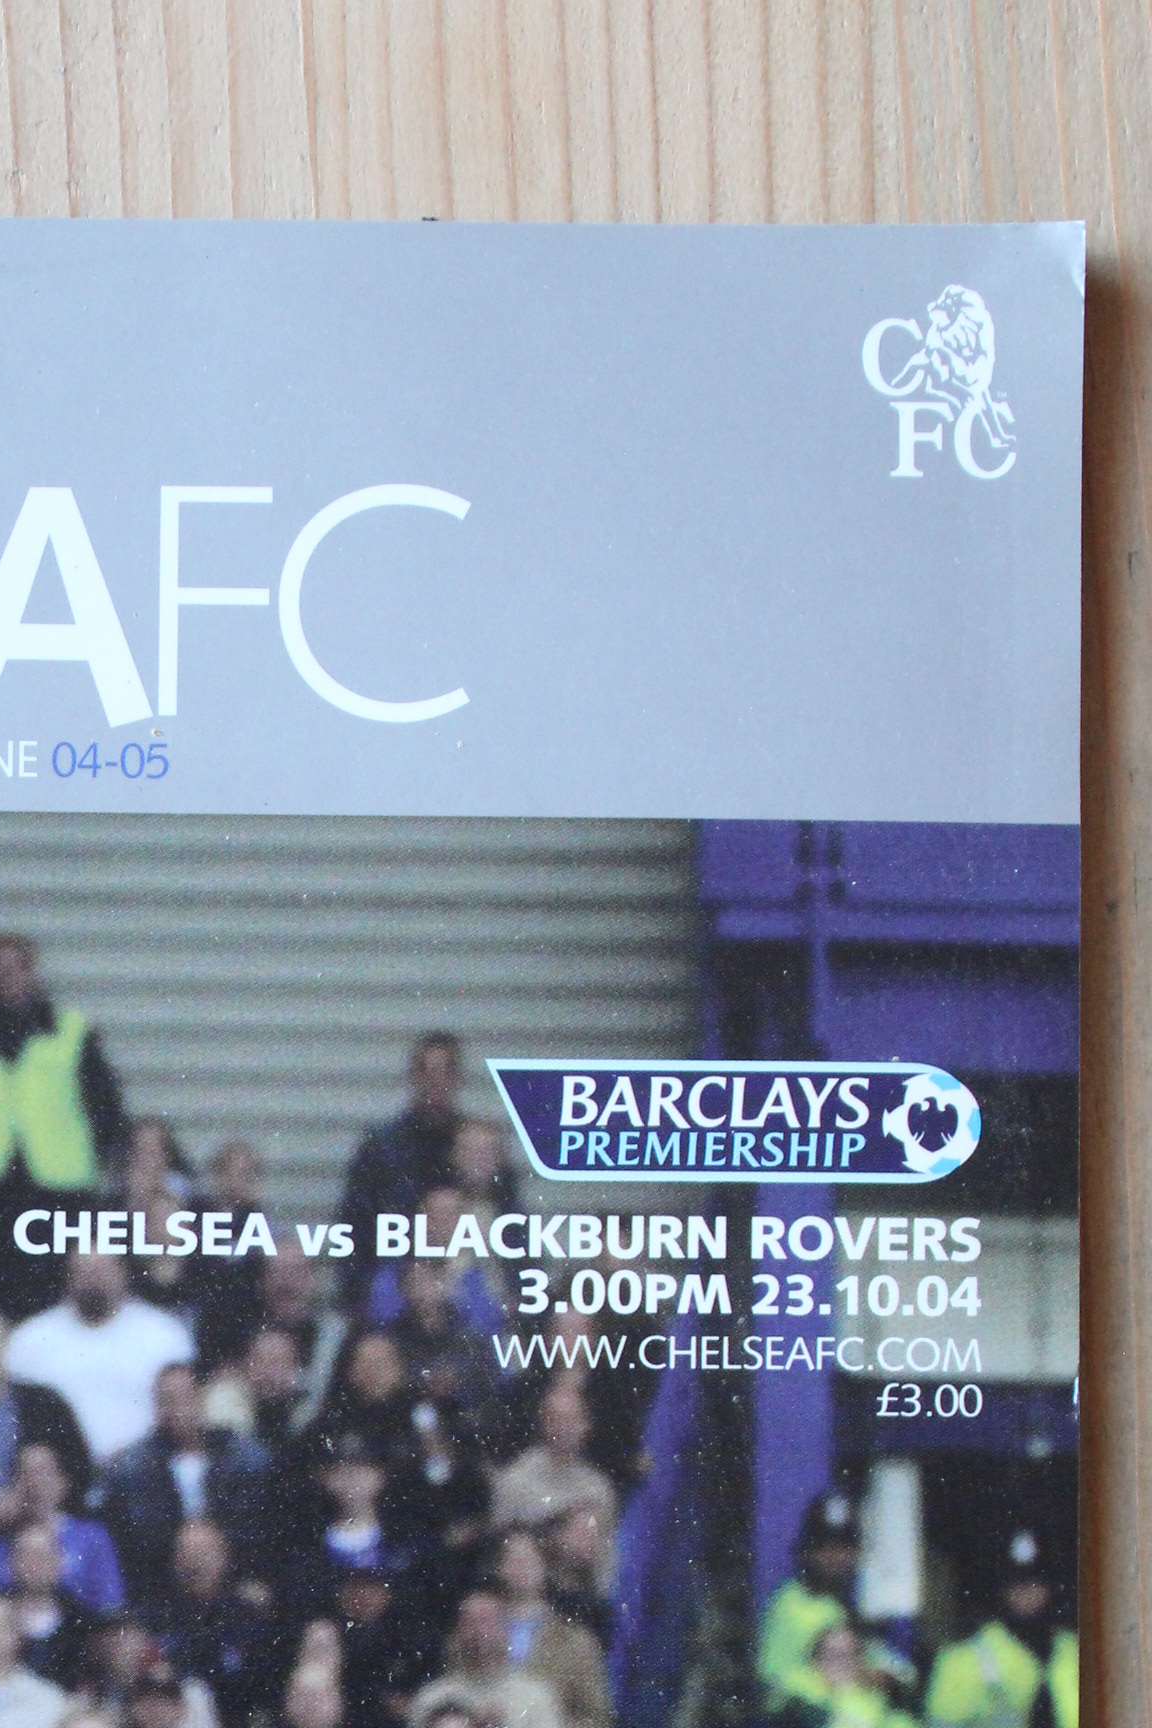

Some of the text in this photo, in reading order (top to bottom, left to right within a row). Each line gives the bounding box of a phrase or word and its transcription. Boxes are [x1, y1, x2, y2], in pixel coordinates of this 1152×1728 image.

[52, 741, 170, 779] 04-05
[558, 1075, 870, 1129] BARCLAYS
[558, 1130, 866, 1168] PREMIERSHIP
[13, 1209, 278, 1257] CHELSEA
[376, 1213, 727, 1260] BLACKBURN
[751, 1216, 981, 1263] ROVERS
[518, 1268, 982, 1318] 3.00PM 23.10.04
[492, 1334, 983, 1373] WWW.CHELSEAFC.COM
[876, 1382, 983, 1418] £3.00
